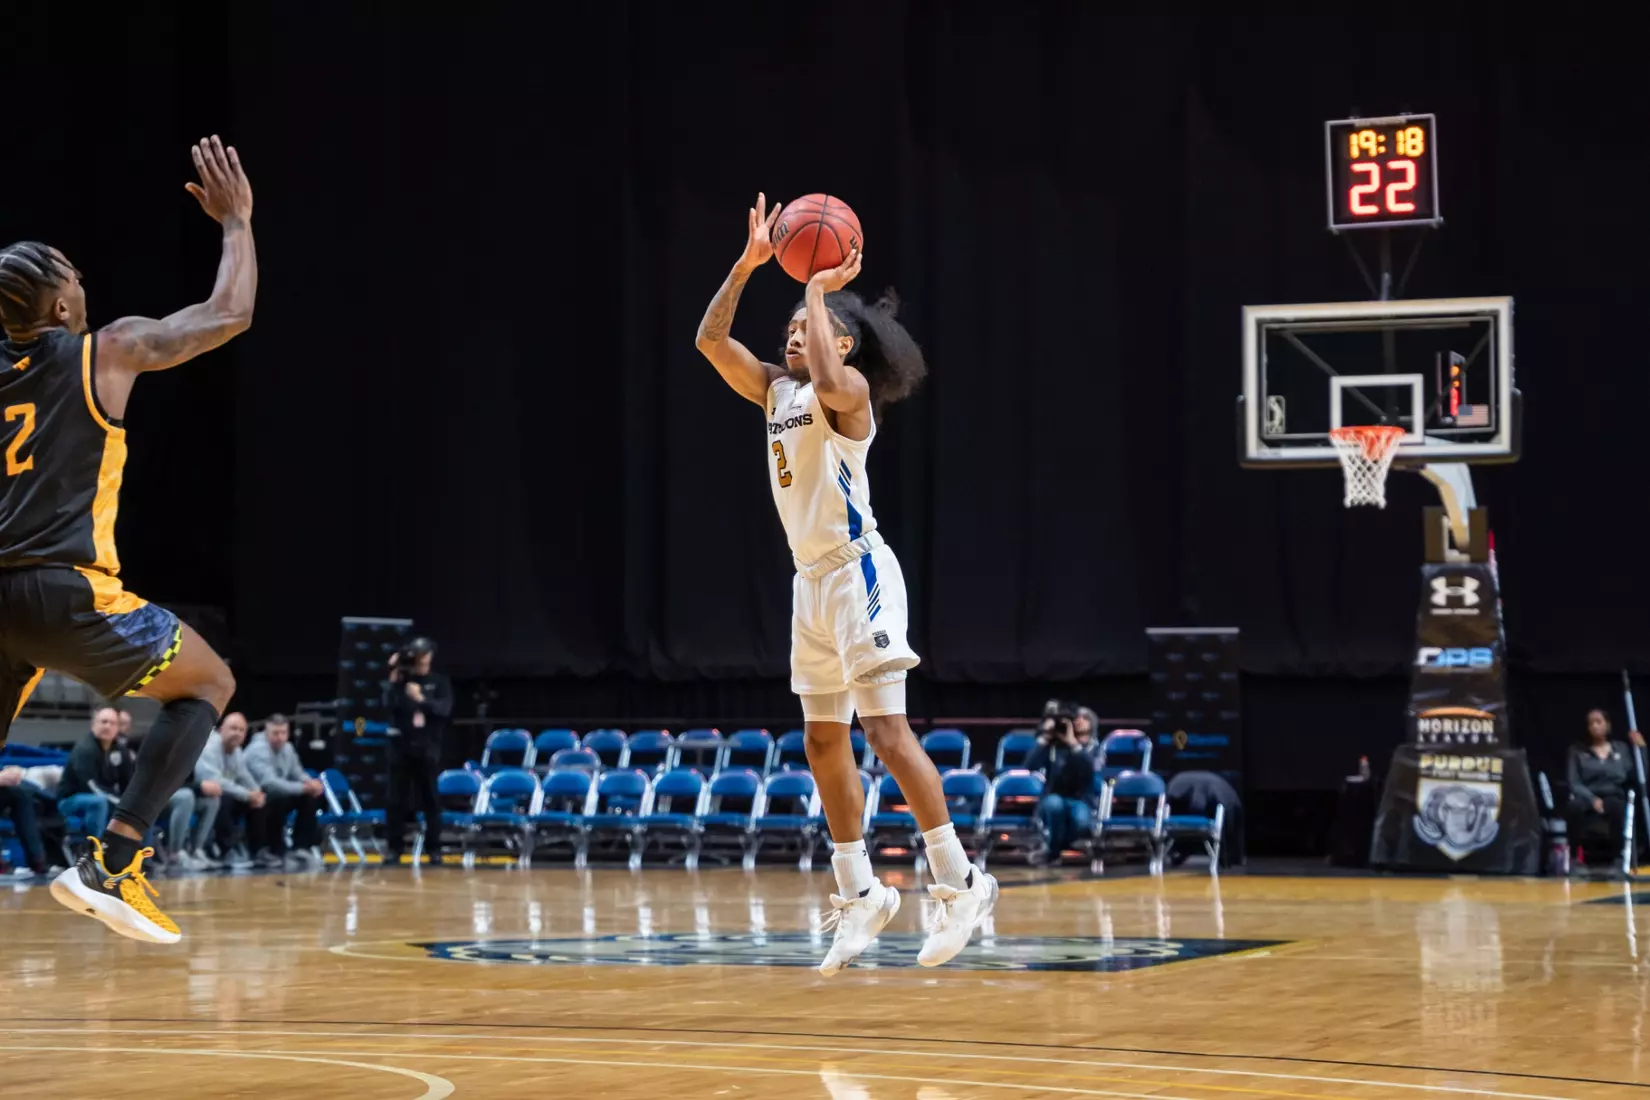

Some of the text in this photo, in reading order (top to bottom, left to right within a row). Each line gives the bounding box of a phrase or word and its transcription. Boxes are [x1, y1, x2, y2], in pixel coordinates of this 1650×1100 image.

[1348, 159, 1417, 216] 22
[4, 402, 36, 476] 2
[772, 439, 793, 488] 2
[1418, 718, 1494, 734] HORIZON
[1419, 754, 1504, 774] PURDUE
